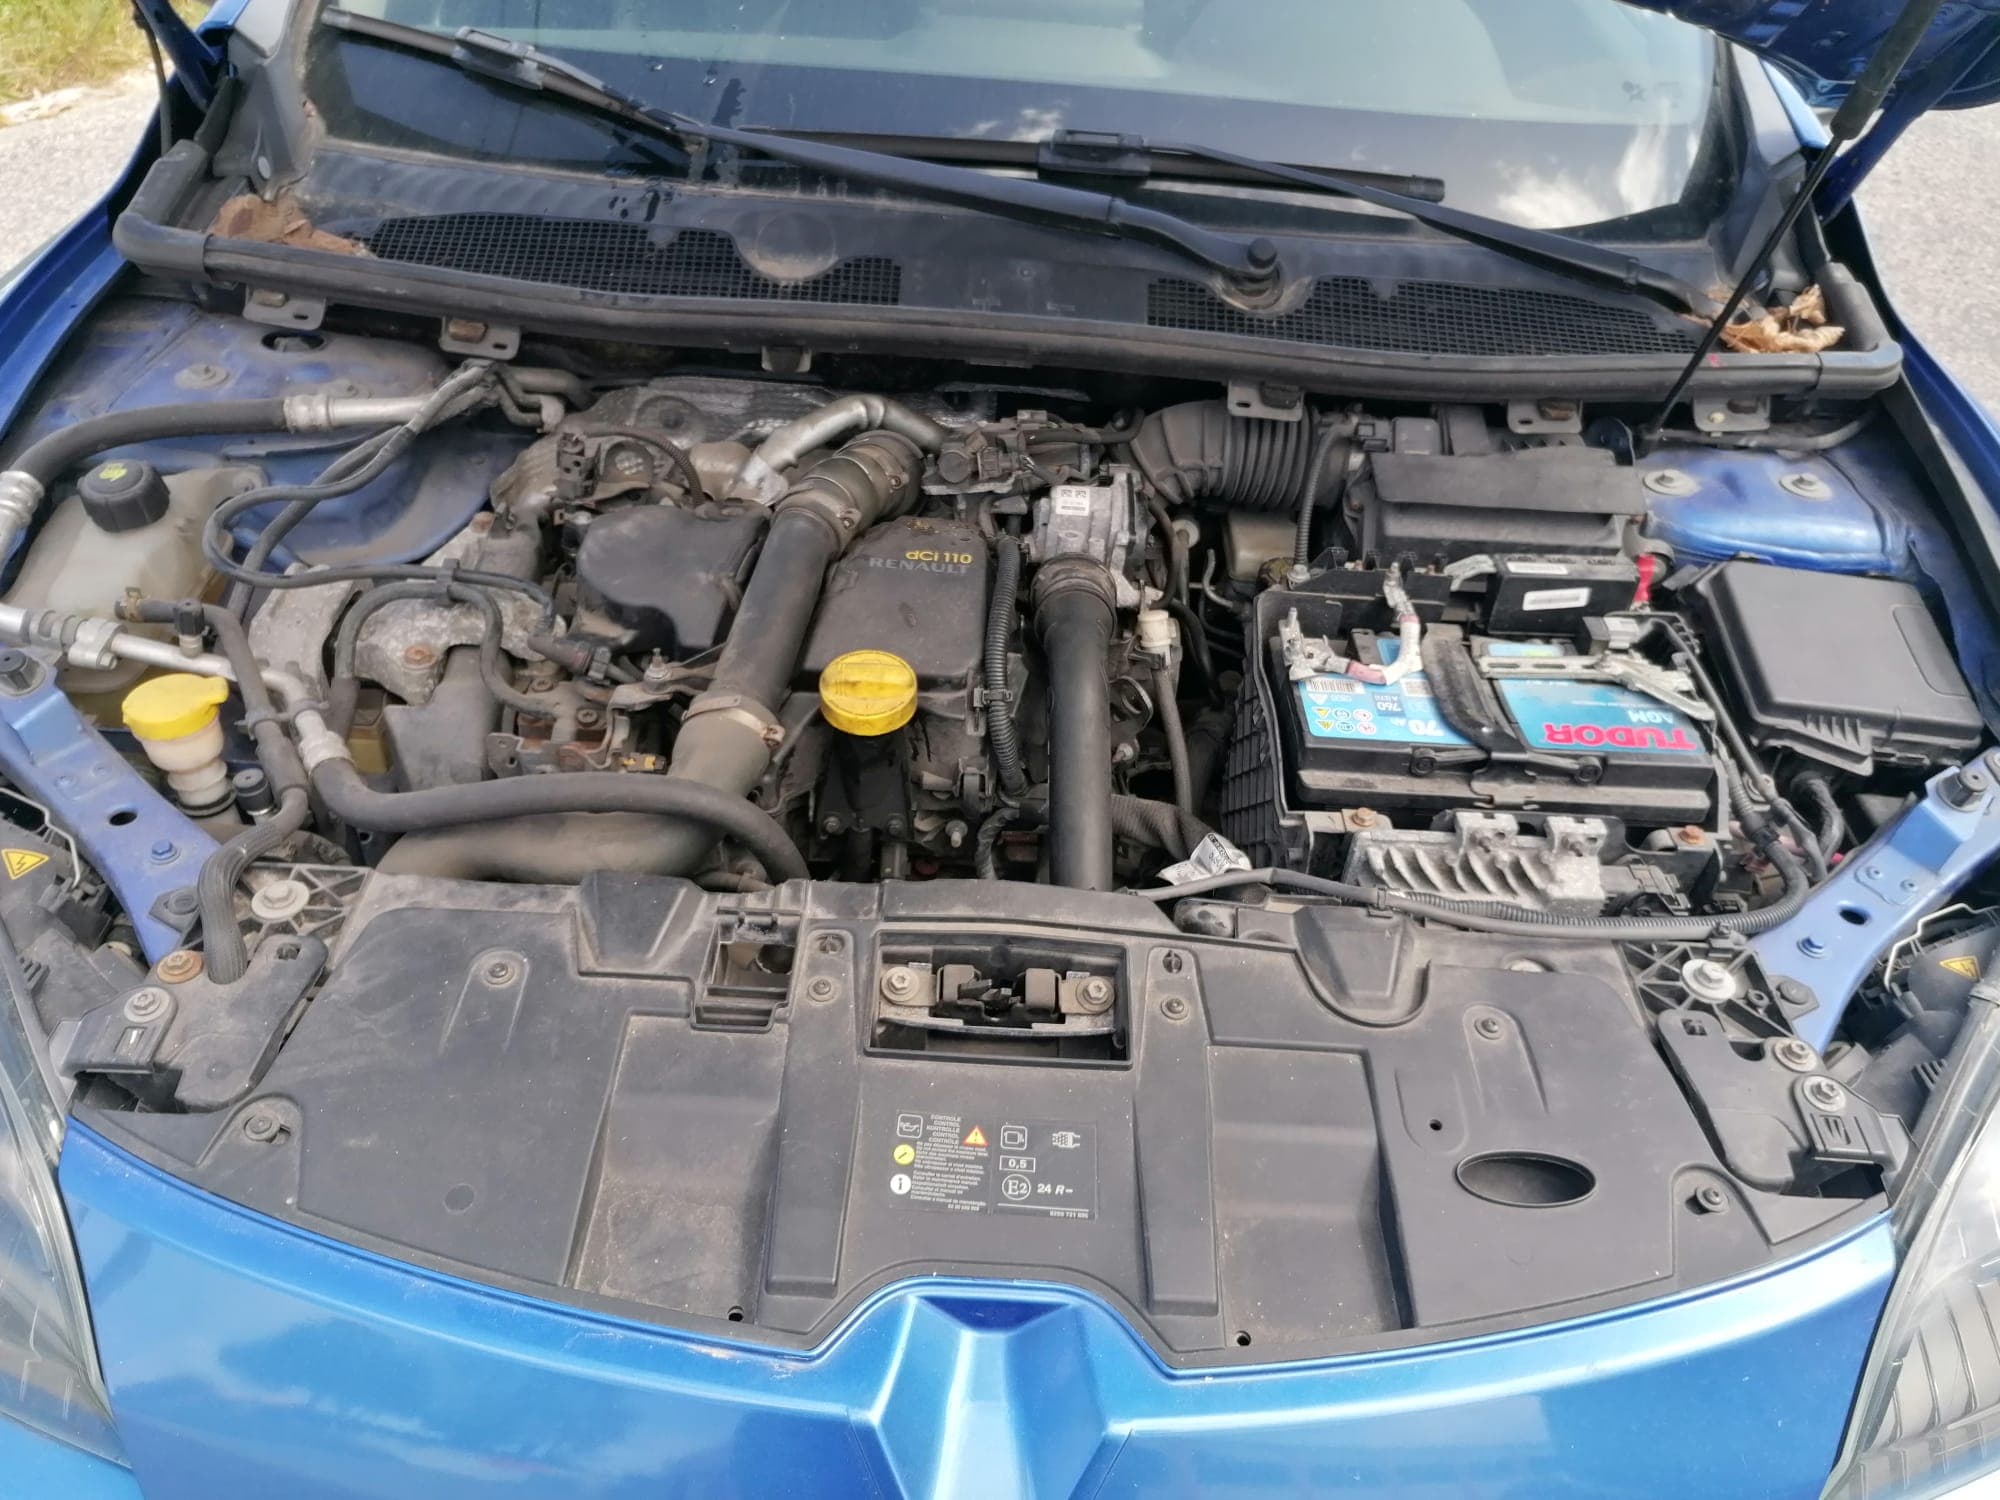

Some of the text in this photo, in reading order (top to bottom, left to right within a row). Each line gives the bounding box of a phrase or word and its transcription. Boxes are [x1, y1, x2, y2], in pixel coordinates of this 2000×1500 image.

[905, 550, 973, 564] dCi 110
[869, 557, 970, 575] RENAULT
[1627, 709, 1675, 725] AGM
[1408, 719, 1445, 737] 70
[1544, 723, 1697, 751] TUDOR
[1008, 1159, 1027, 1169] 0,5
[1007, 1180, 1028, 1196] E2
[1037, 1184, 1052, 1193] 24
